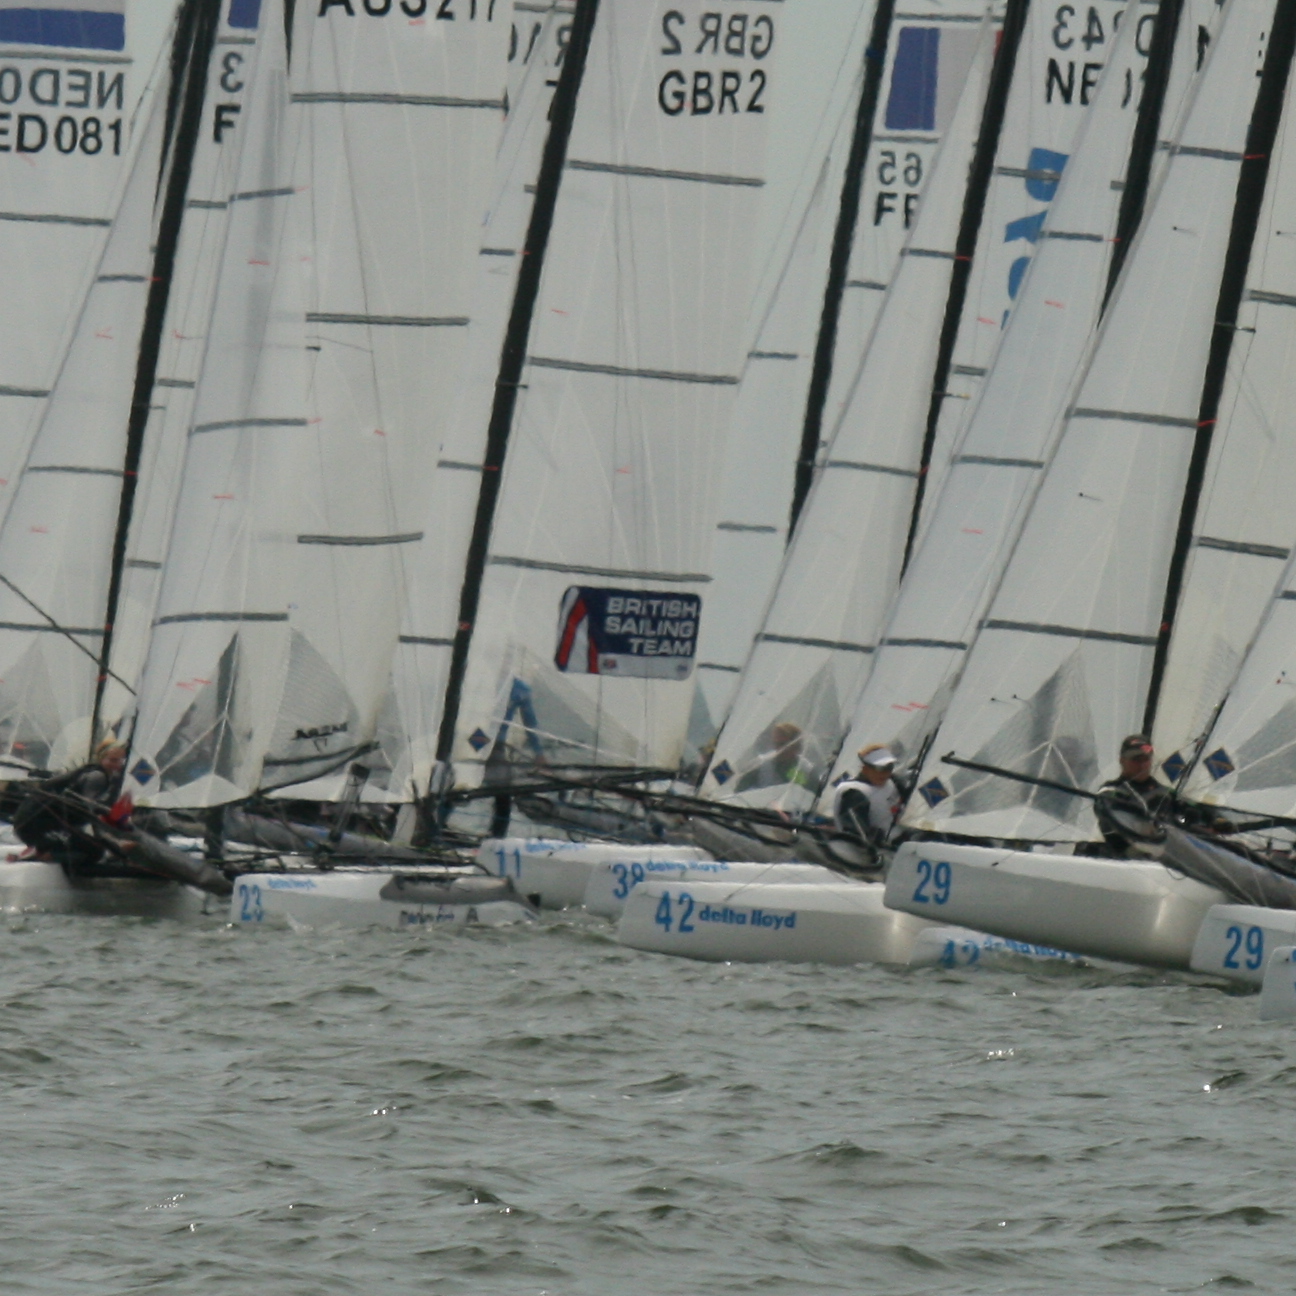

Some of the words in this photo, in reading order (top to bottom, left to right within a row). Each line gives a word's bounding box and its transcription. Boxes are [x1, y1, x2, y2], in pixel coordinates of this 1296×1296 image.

[657, 70, 766, 116] GBR2
[605, 615, 696, 638] SAILING
[607, 596, 698, 619] BRITISH
[628, 637, 692, 656] TEAM
[912, 860, 952, 905] 29
[655, 890, 695, 933] 42
[698, 905, 747, 926] delta
[750, 908, 796, 931] lloyd
[1223, 926, 1264, 971] 29
